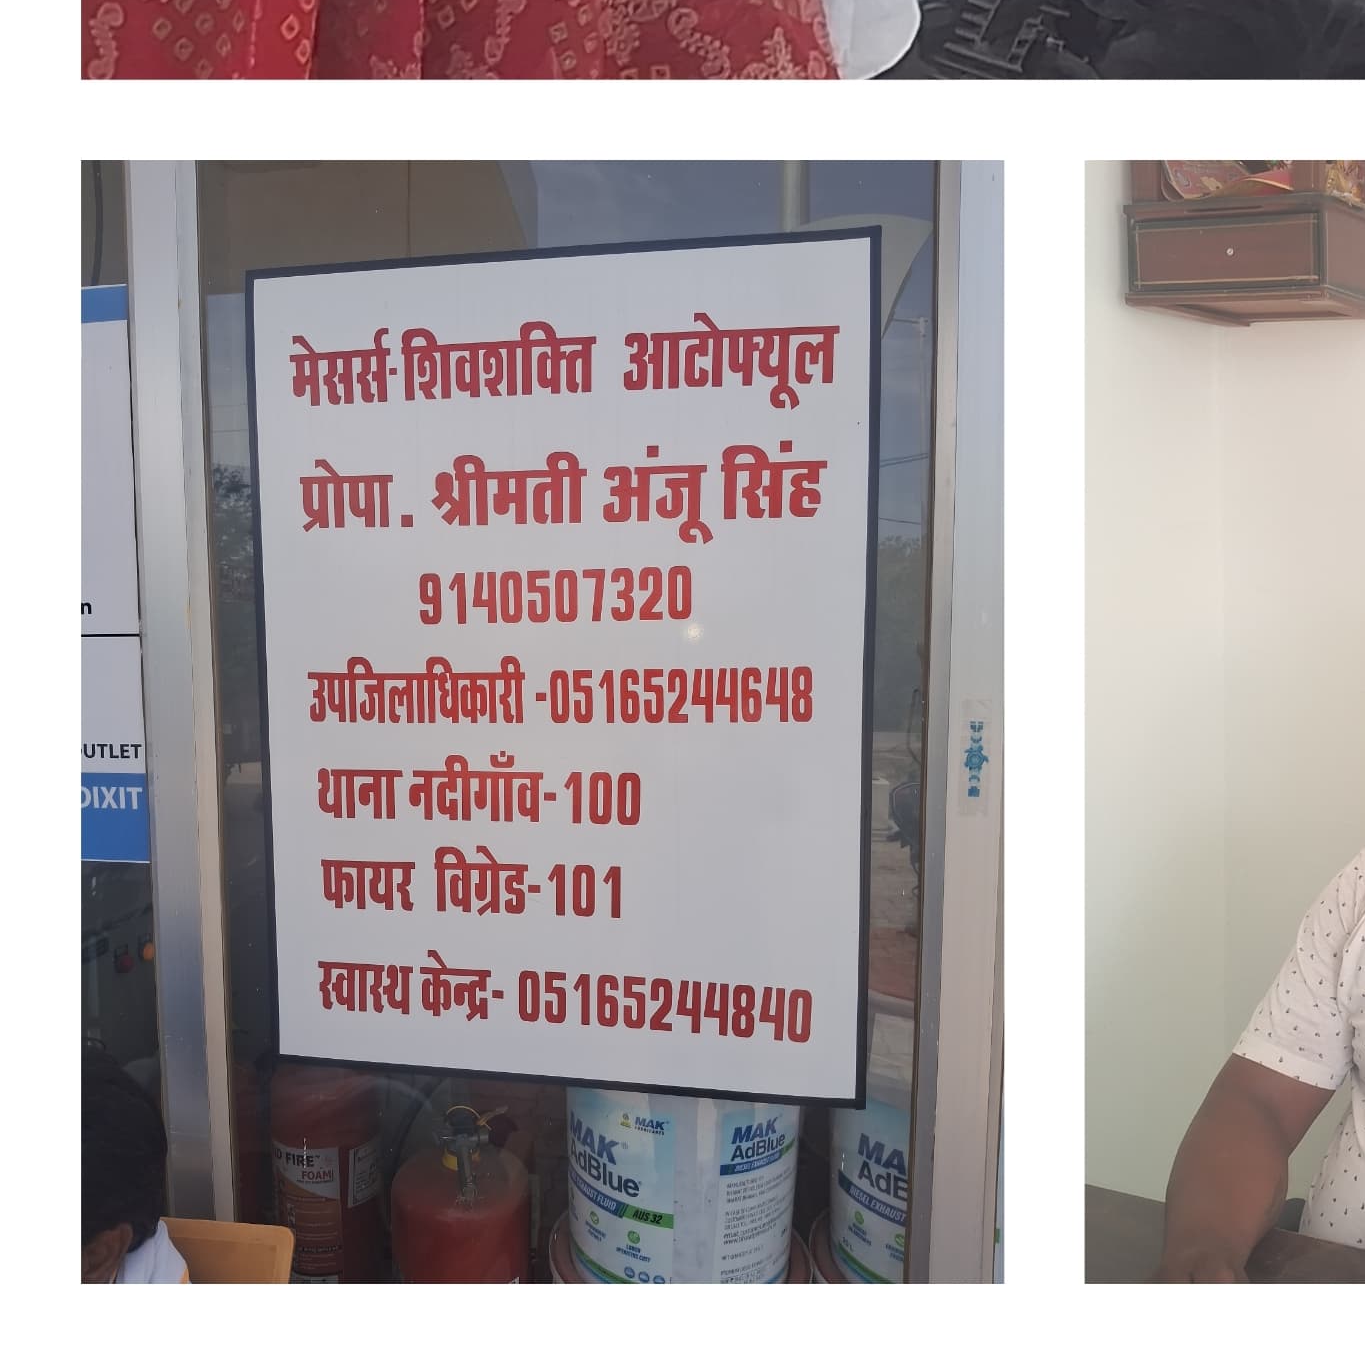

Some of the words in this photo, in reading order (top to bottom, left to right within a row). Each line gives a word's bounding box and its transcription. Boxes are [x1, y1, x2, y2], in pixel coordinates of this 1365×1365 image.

[623, 312, 840, 409] आटोफ्यूल
[431, 451, 587, 526] श्रीमती
[602, 445, 714, 544] अंजू
[721, 440, 828, 520] सिंह
[418, 566, 693, 625] 9140507320
[307, 655, 525, 724] उपजिलाधिकारी
[81, 743, 142, 759] UTLET
[318, 767, 402, 819] थाना
[321, 859, 415, 911] फायर
[518, 970, 813, 1044] 05165244840
[570, 1110, 620, 1166] MAK
[634, 1116, 665, 1131] MAK
[730, 1133, 786, 1162] AdBlue
[731, 1116, 778, 1145] MAK
[285, 1151, 315, 1168] FIRE
[571, 1138, 640, 1198] AdBlue
[858, 1132, 907, 1176] MA
[858, 1160, 908, 1202] AdB
[632, 1209, 650, 1222] AUS
[650, 1213, 663, 1225] 32
